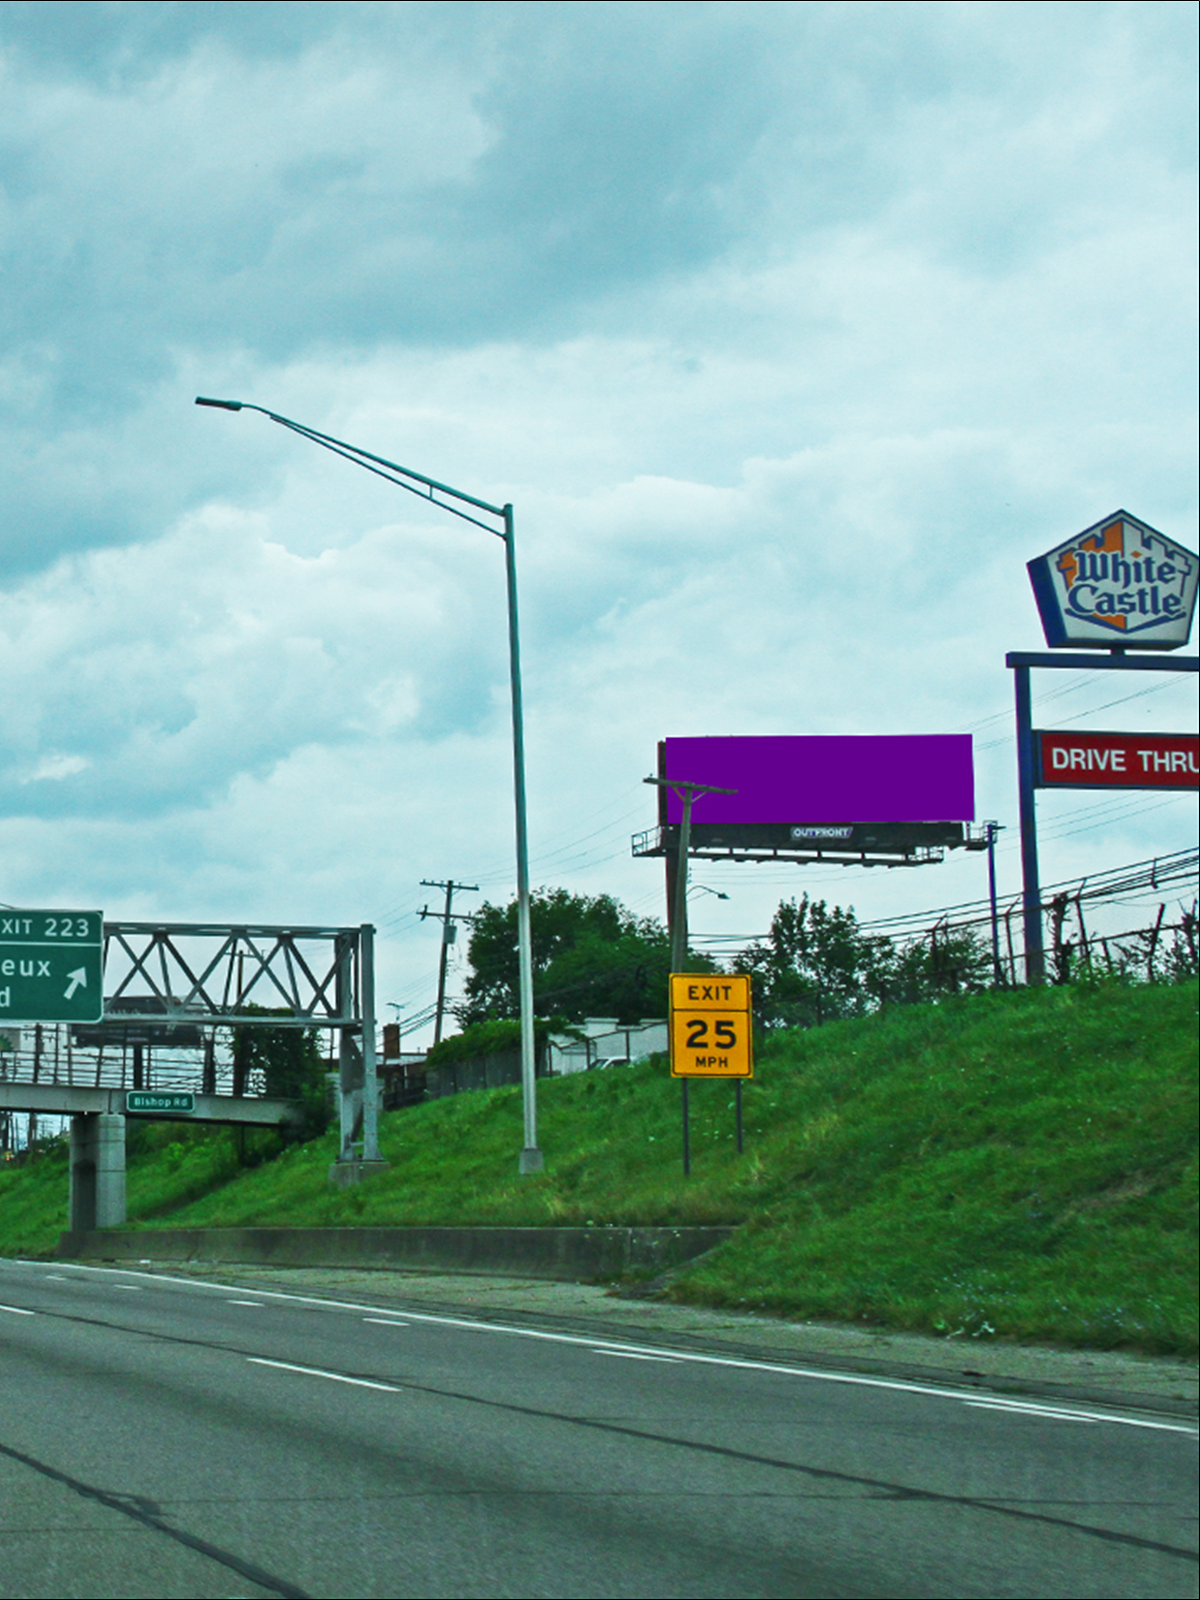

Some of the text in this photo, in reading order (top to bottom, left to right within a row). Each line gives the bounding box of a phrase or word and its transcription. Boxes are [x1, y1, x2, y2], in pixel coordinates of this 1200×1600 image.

[1074, 551, 1177, 589] White
[1068, 584, 1182, 616] Castle
[1052, 747, 1199, 773] DRIVE THRU
[44, 918, 90, 937] 223
[688, 985, 732, 1001] EXIT
[686, 1019, 737, 1050] 25
[695, 1056, 728, 1068] MPH
[134, 1097, 188, 1108] Bishop Rd
